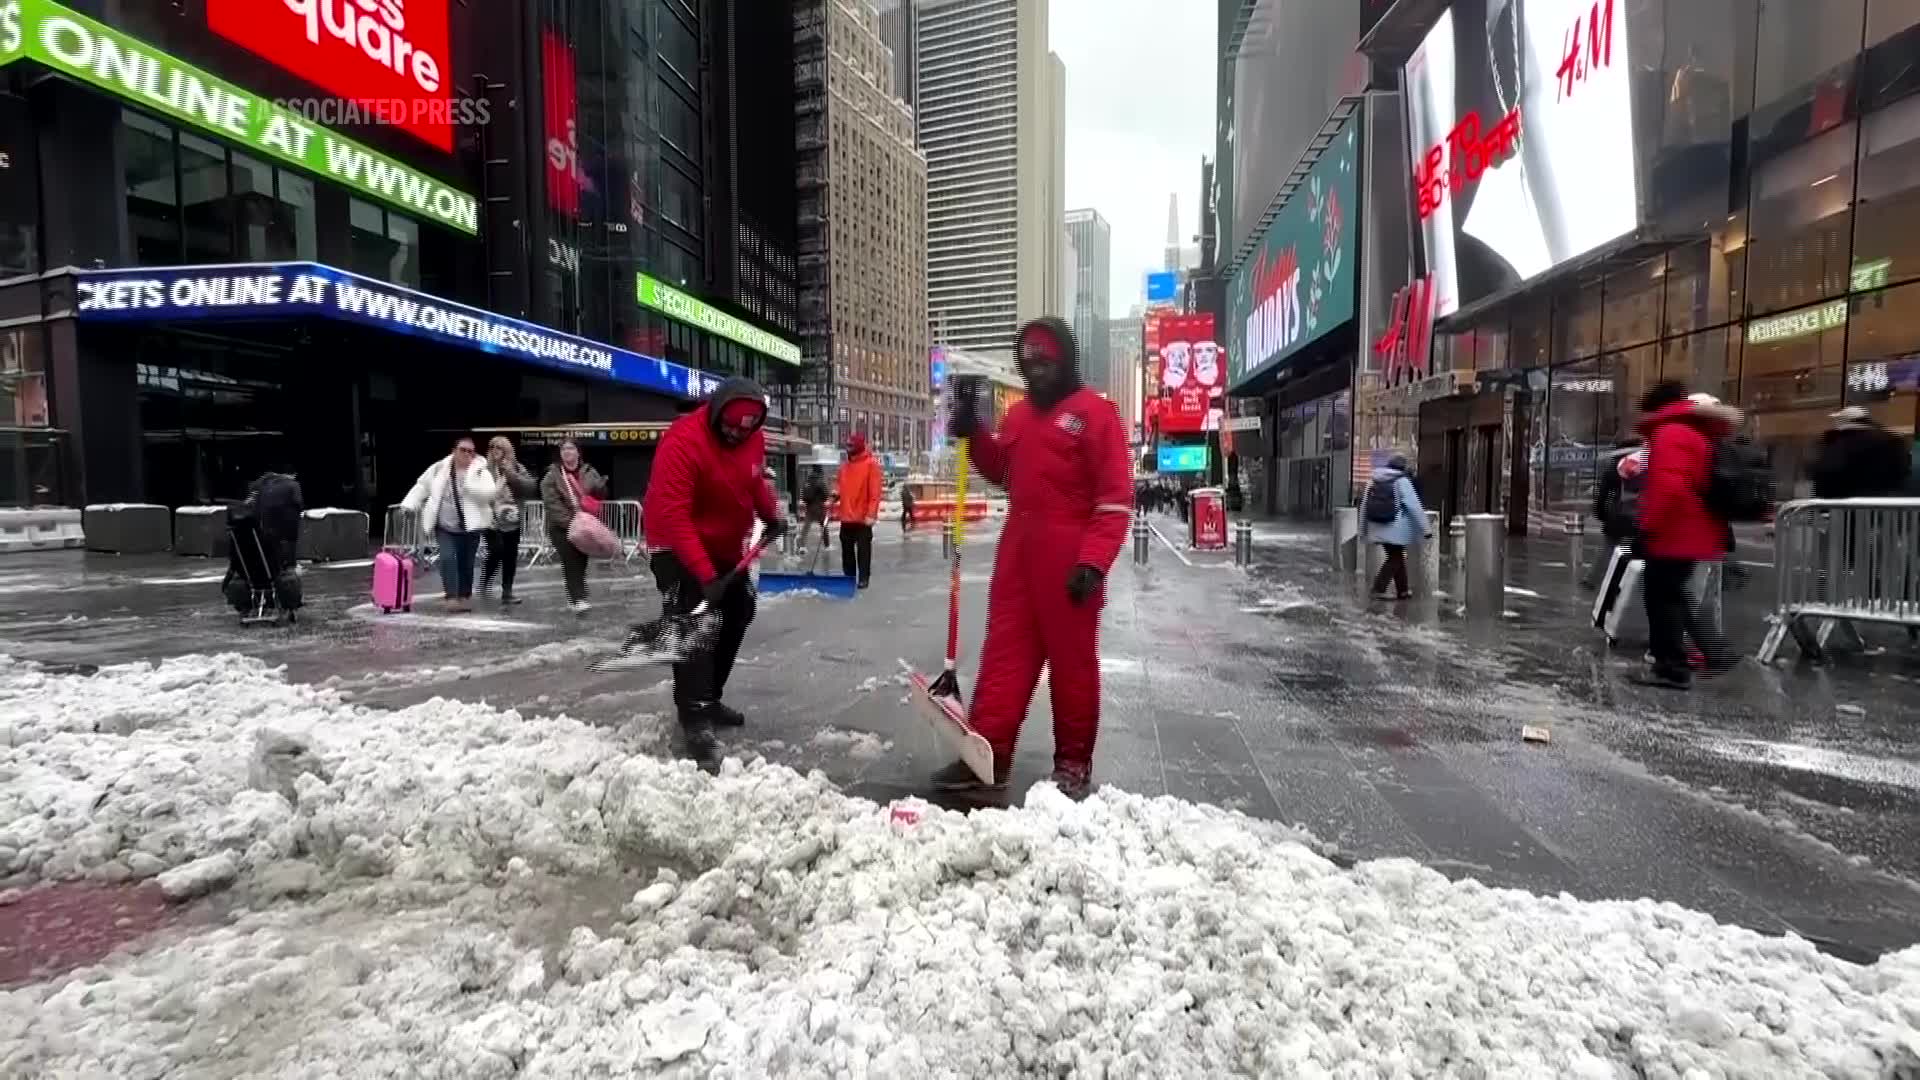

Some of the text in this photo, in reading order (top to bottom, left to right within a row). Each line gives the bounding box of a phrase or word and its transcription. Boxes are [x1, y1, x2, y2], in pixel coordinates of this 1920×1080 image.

[1556, 0, 1614, 104] H&M
[38, 16, 250, 137] ONLINE
[260, 115, 315, 159] AT
[323, 138, 478, 230] WWW.ON
[1415, 111, 1480, 189] UP TO
[1466, 105, 1521, 179] OFF
[170, 276, 283, 306] ONLINE
[288, 275, 331, 303] AT
[335, 282, 613, 370] WWW.ONETIMESSQUARE.COM
[1246, 266, 1300, 373] HOLIDAYS
